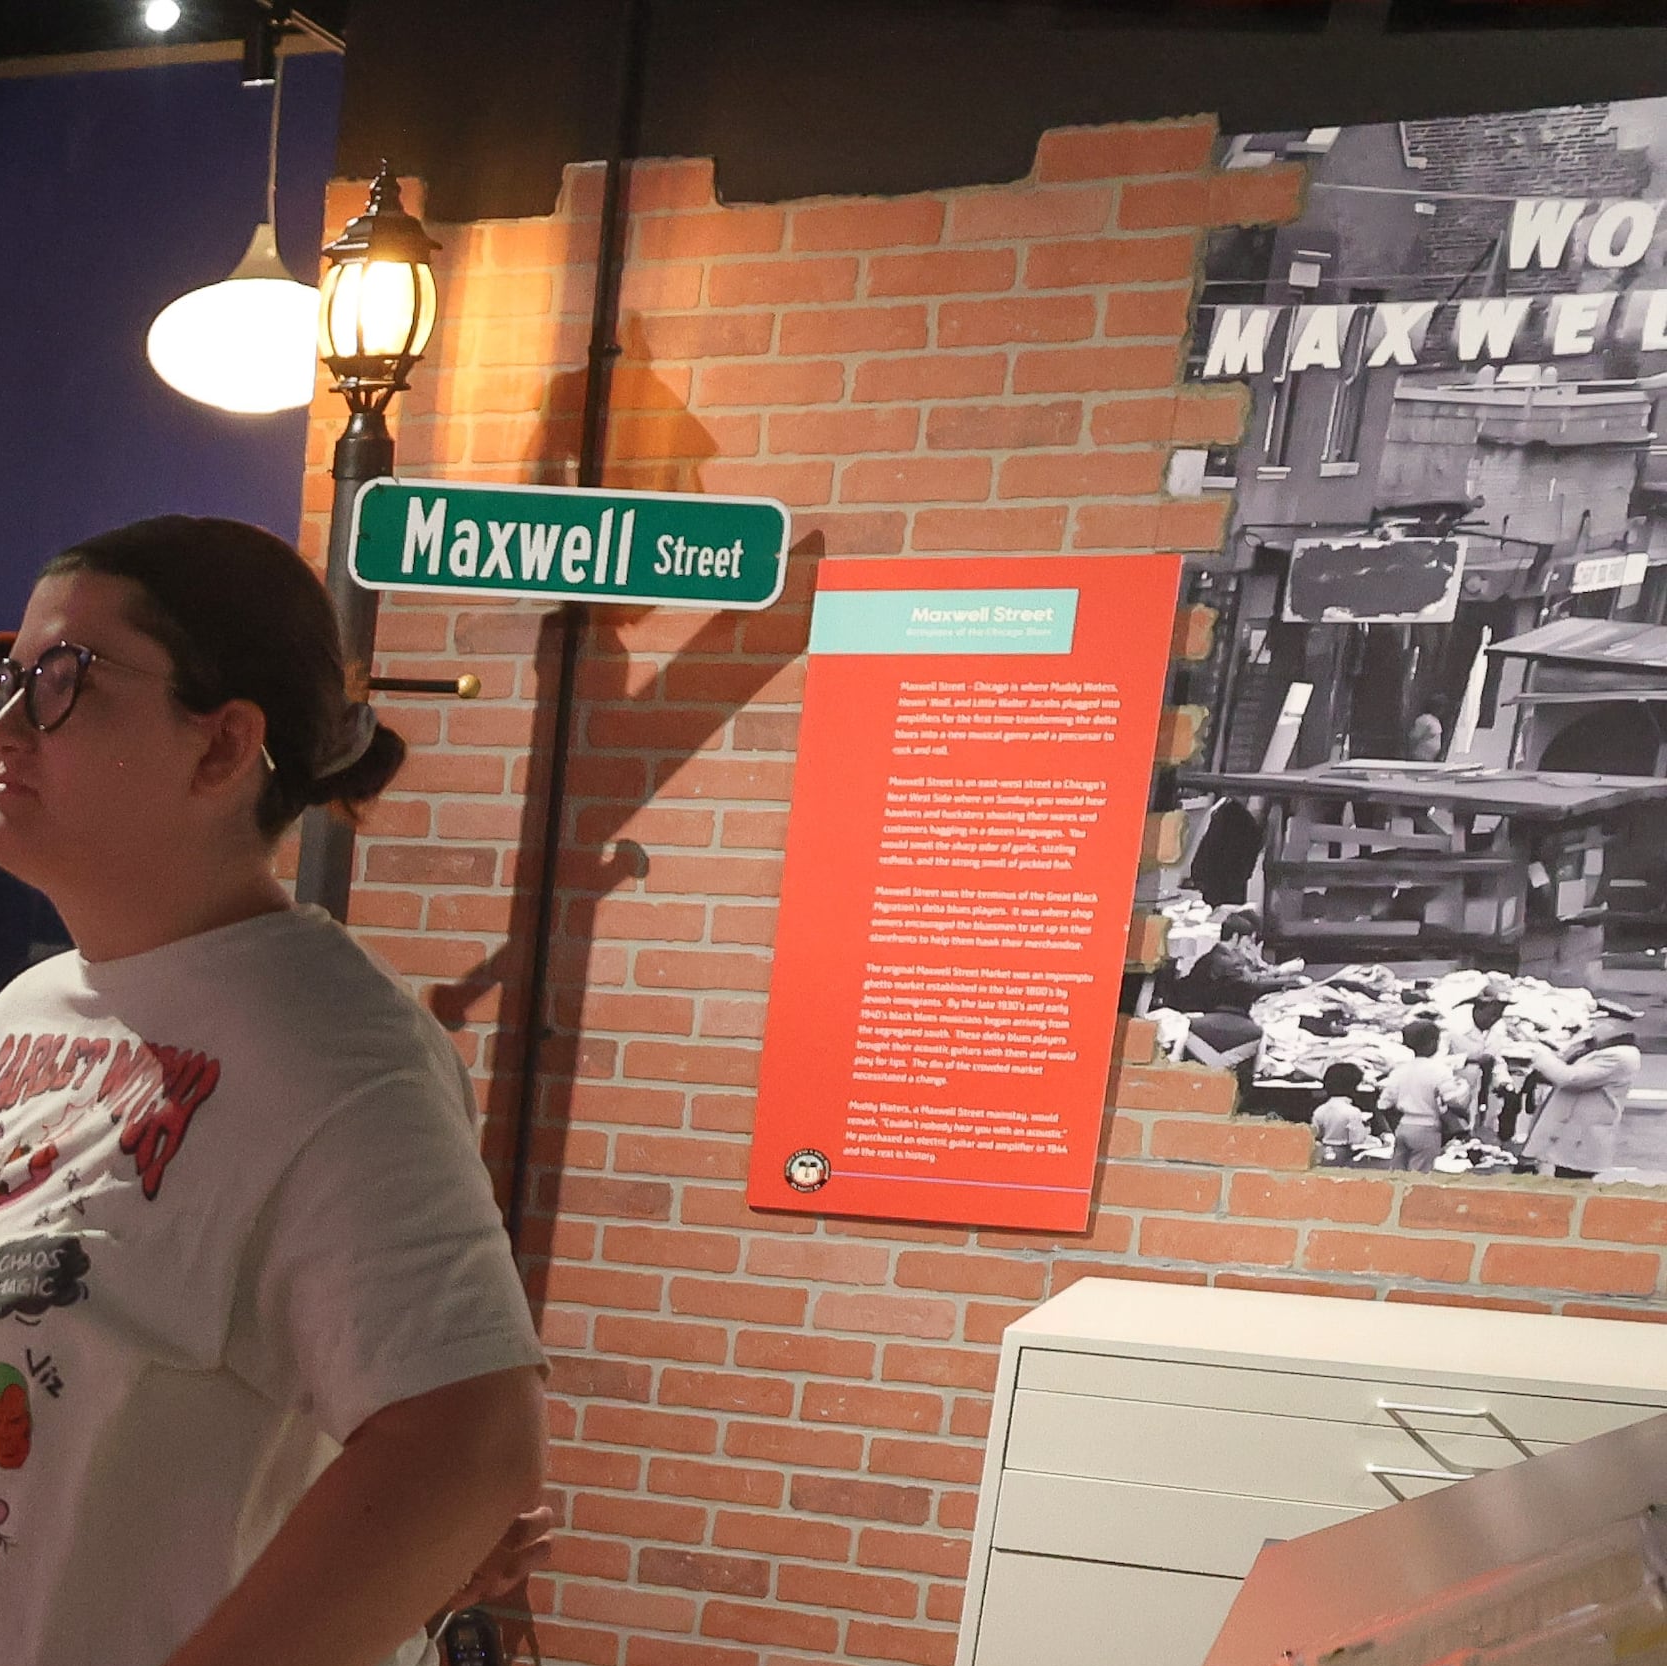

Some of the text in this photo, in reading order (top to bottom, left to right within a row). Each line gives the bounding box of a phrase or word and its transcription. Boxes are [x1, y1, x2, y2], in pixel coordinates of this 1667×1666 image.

[401, 497, 744, 586] Maxwell Street
[911, 605, 1055, 623] Maxwell Street
[26, 1349, 65, 1399] Viz
